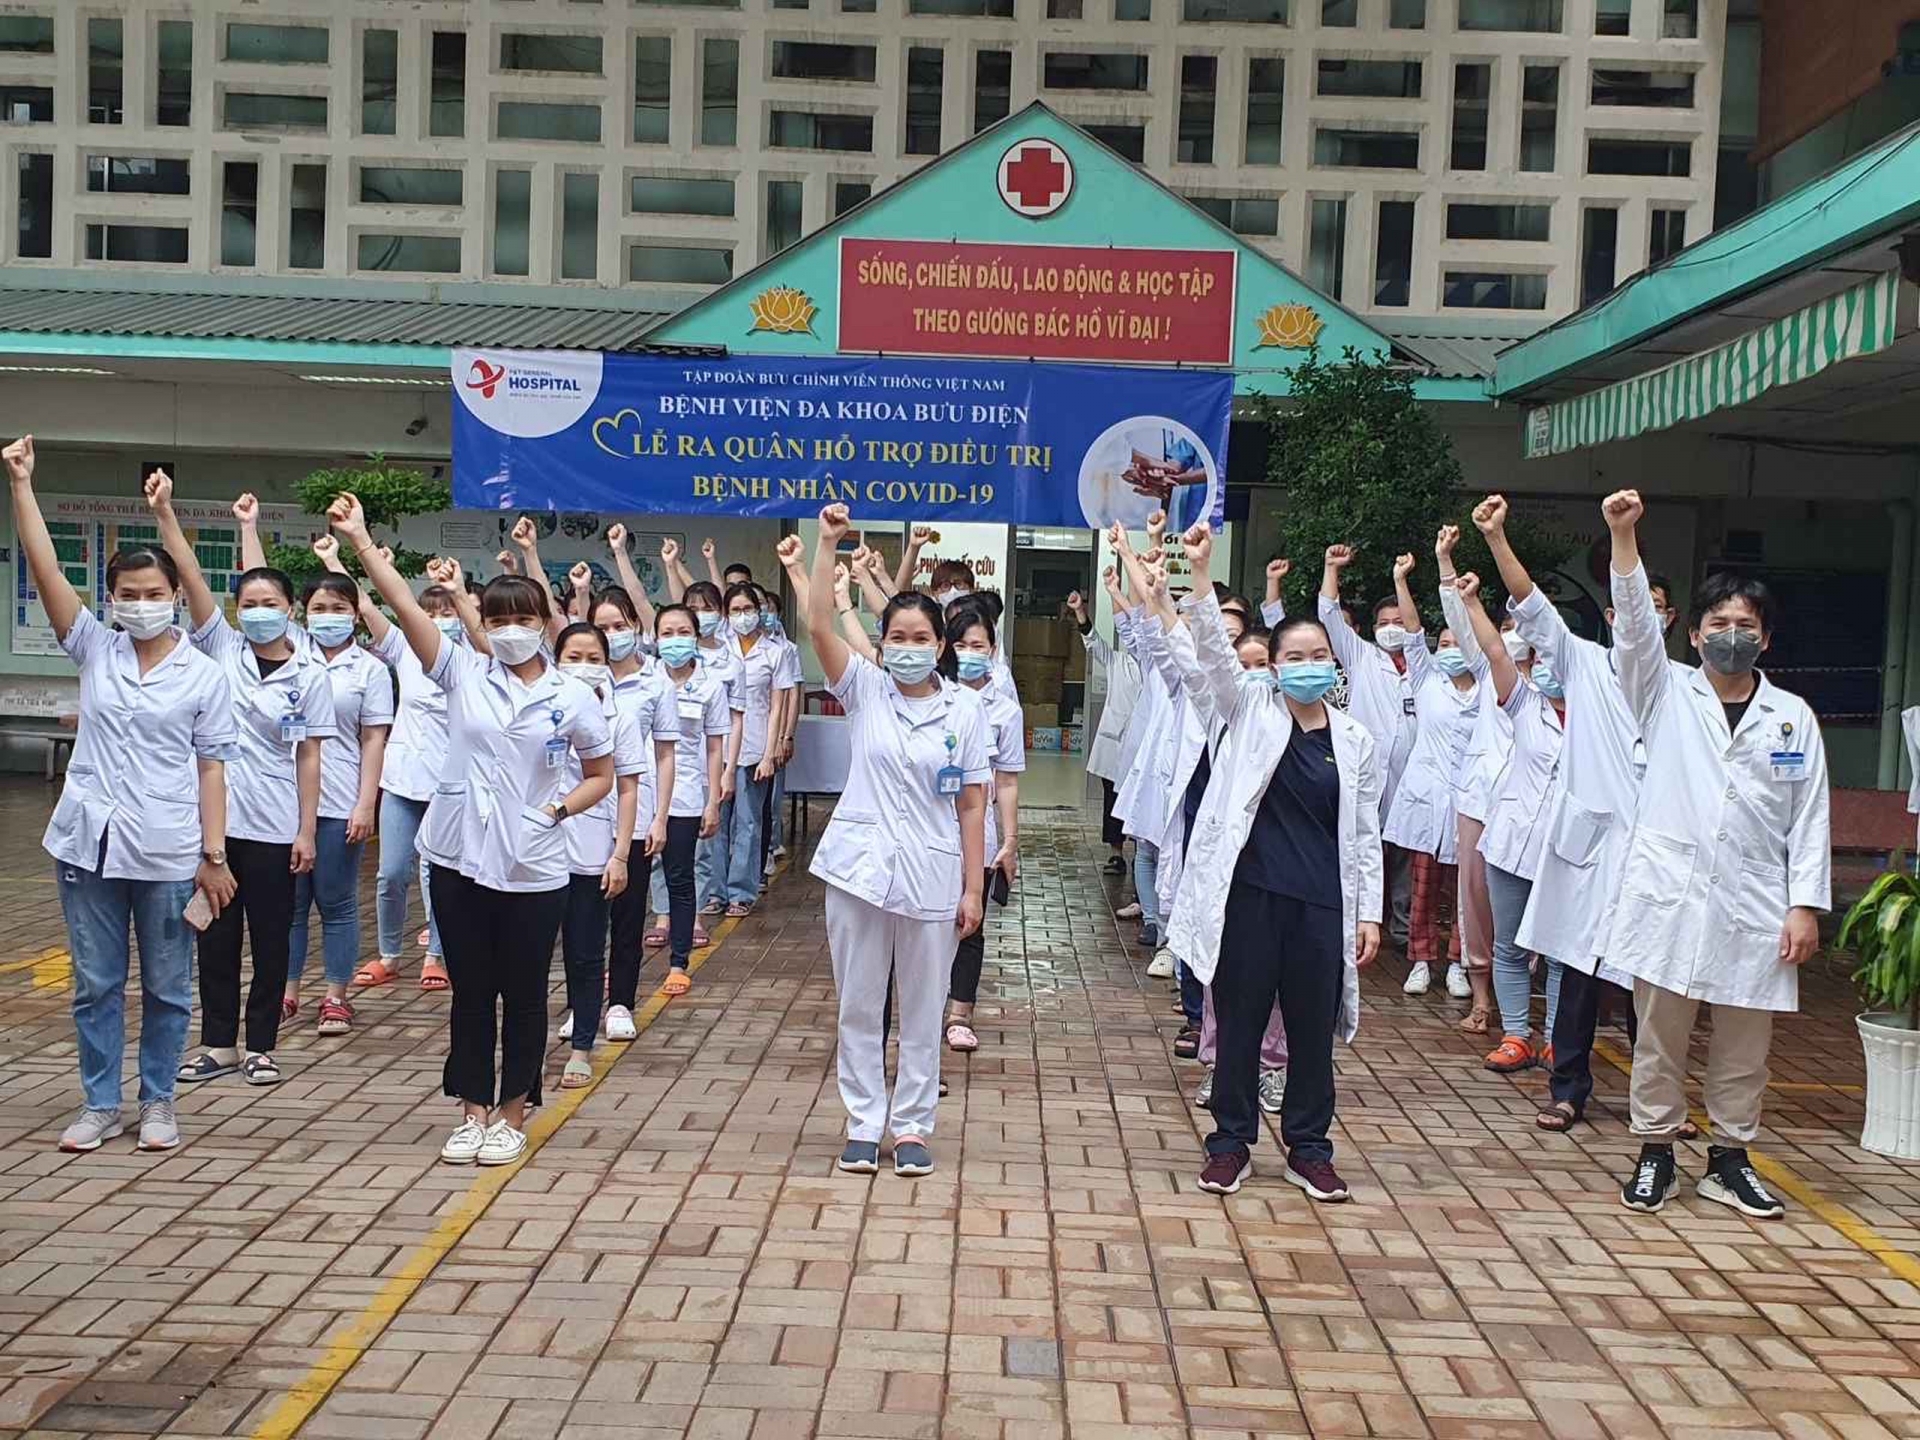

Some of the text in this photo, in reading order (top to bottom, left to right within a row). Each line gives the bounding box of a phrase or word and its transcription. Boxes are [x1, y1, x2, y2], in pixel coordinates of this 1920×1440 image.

[857, 250, 1214, 303] SỐNG, CHIẾN ĐẤU, LAO ĐỘNG & HỌC TẬP
[913, 307, 961, 333] THEO
[965, 306, 1029, 336] GƯƠNG
[1034, 308, 1070, 337] BÁC
[1076, 306, 1102, 339] HỒ
[1107, 309, 1126, 339] VĨ
[508, 376, 582, 391] HOSPITAL
[682, 370, 712, 386] TẬP
[714, 368, 755, 385] ĐOÀN
[759, 370, 788, 385] BƯU
[793, 371, 839, 387] CHÍNH
[880, 373, 932, 390] THÔNG
[936, 376, 967, 393] VIỆT
[972, 378, 1005, 391] NAM
[659, 395, 1029, 430] BỆNH VIỆN ĐA KHOA BƯU ĐIỆN
[633, 428, 1053, 473] LỄ RA QUÂN HỖ TRỢ ĐIỀU TRỊ
[692, 473, 994, 505] BỆNH NHÂN COVID-19
